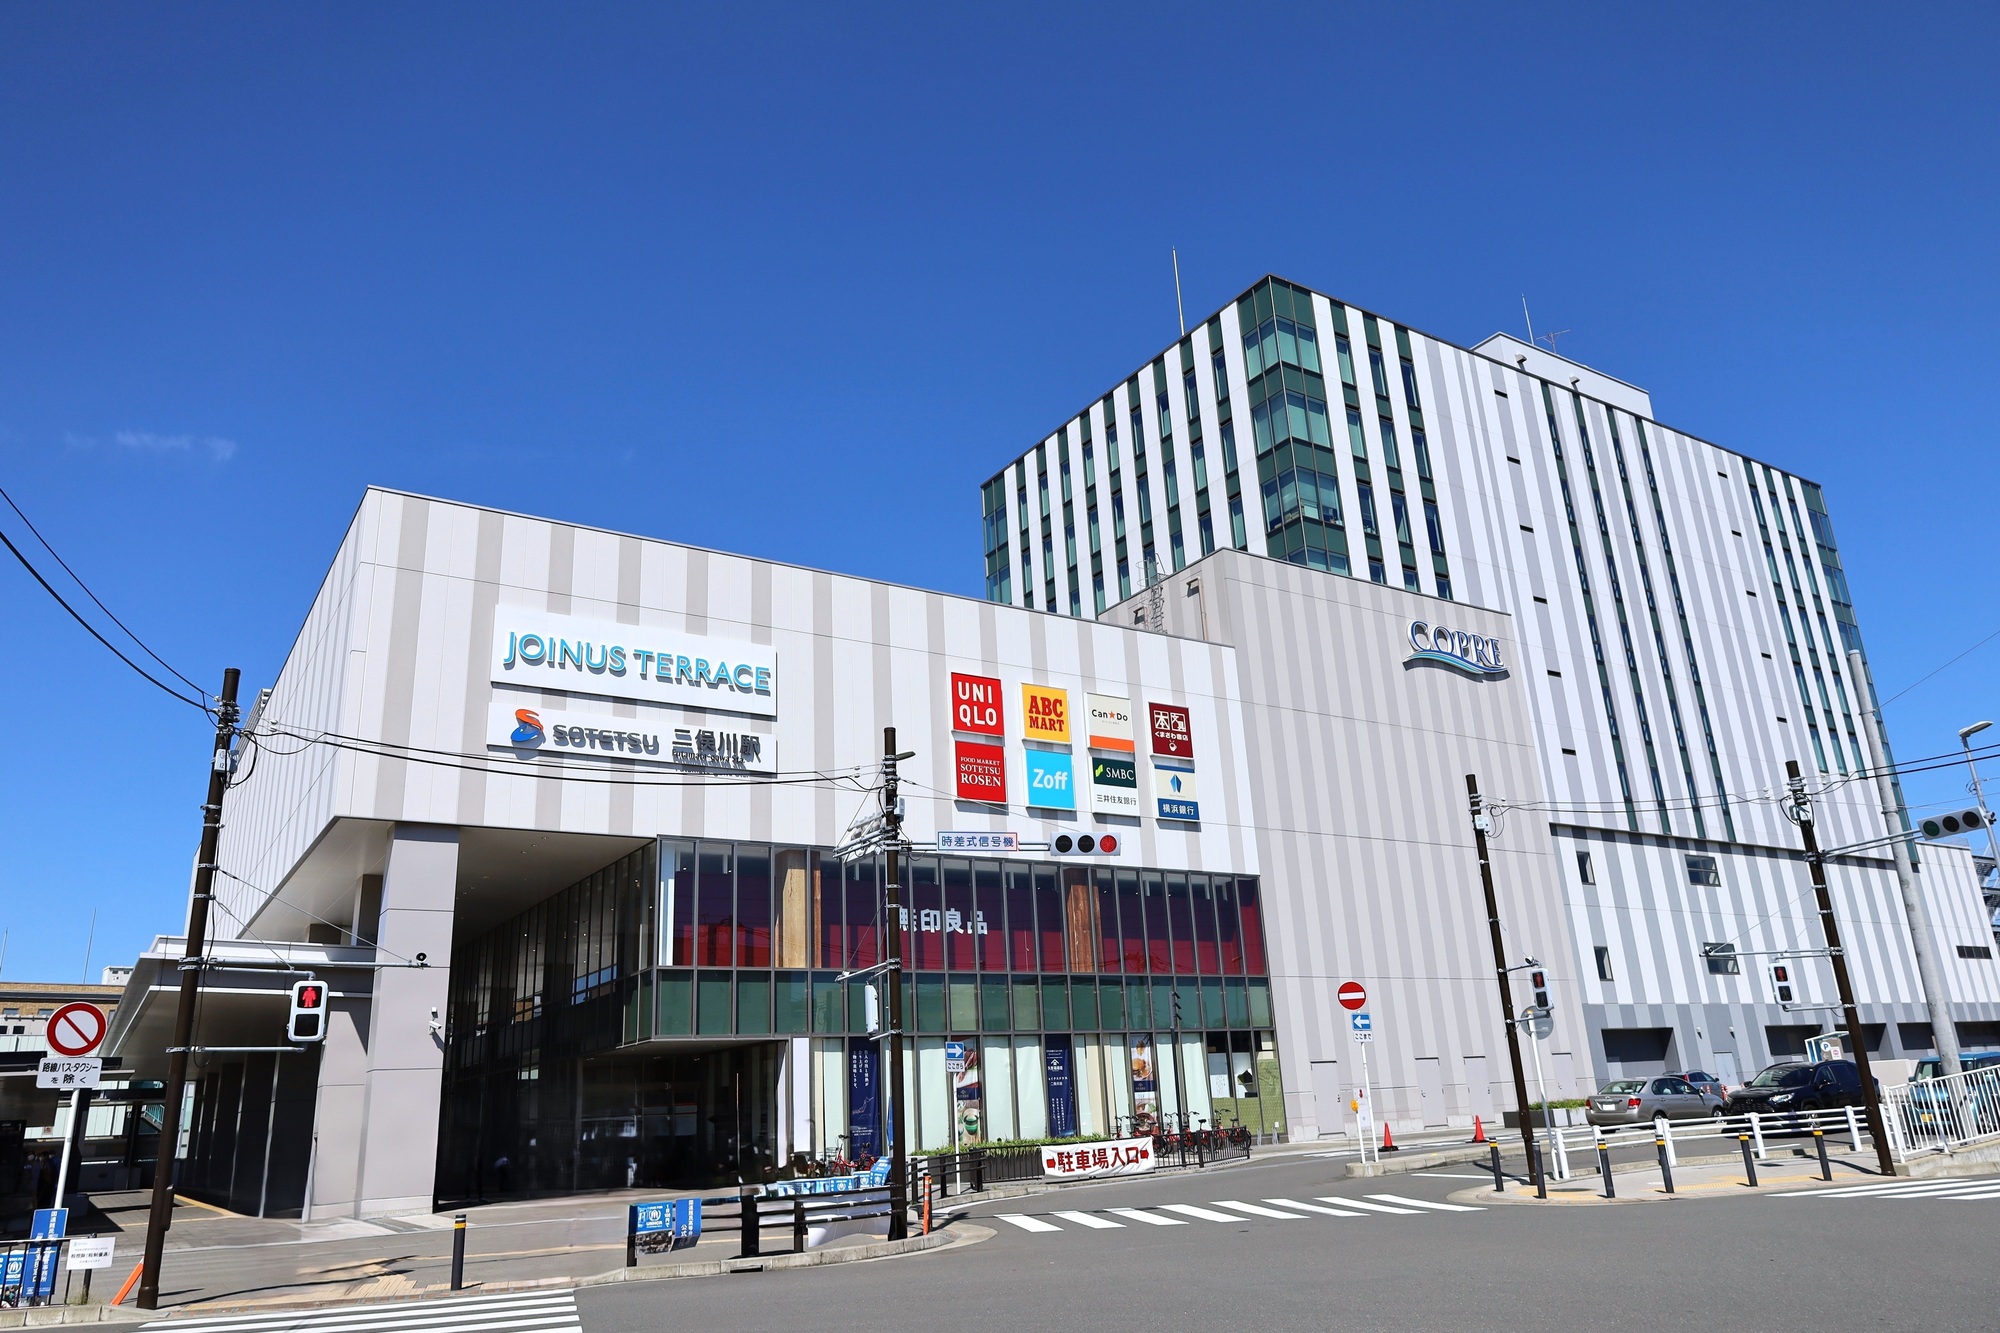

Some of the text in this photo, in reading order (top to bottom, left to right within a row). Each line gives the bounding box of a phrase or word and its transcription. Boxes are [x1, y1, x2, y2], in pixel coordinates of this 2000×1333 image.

[1408, 619, 1504, 667] COPRE
[504, 631, 770, 690] JOINUS TERRACE
[957, 680, 993, 704] UNI
[959, 704, 997, 726] QLO
[1029, 695, 1063, 717] ABC
[1029, 716, 1065, 733] MART
[552, 724, 659, 749] SOTETSU
[960, 764, 1001, 775] SOTETSU
[977, 758, 1001, 766] MARKET
[960, 773, 1002, 787] ROSEN
[1032, 769, 1068, 790] Zoff
[1106, 767, 1135, 781] SMBC
[1096, 794, 1138, 807] 三井住友銀行
[1162, 803, 1194, 816] 横浜銀行
[941, 836, 1013, 848] 時差式信号機
[1057, 1147, 1140, 1173] 駐車場入口
